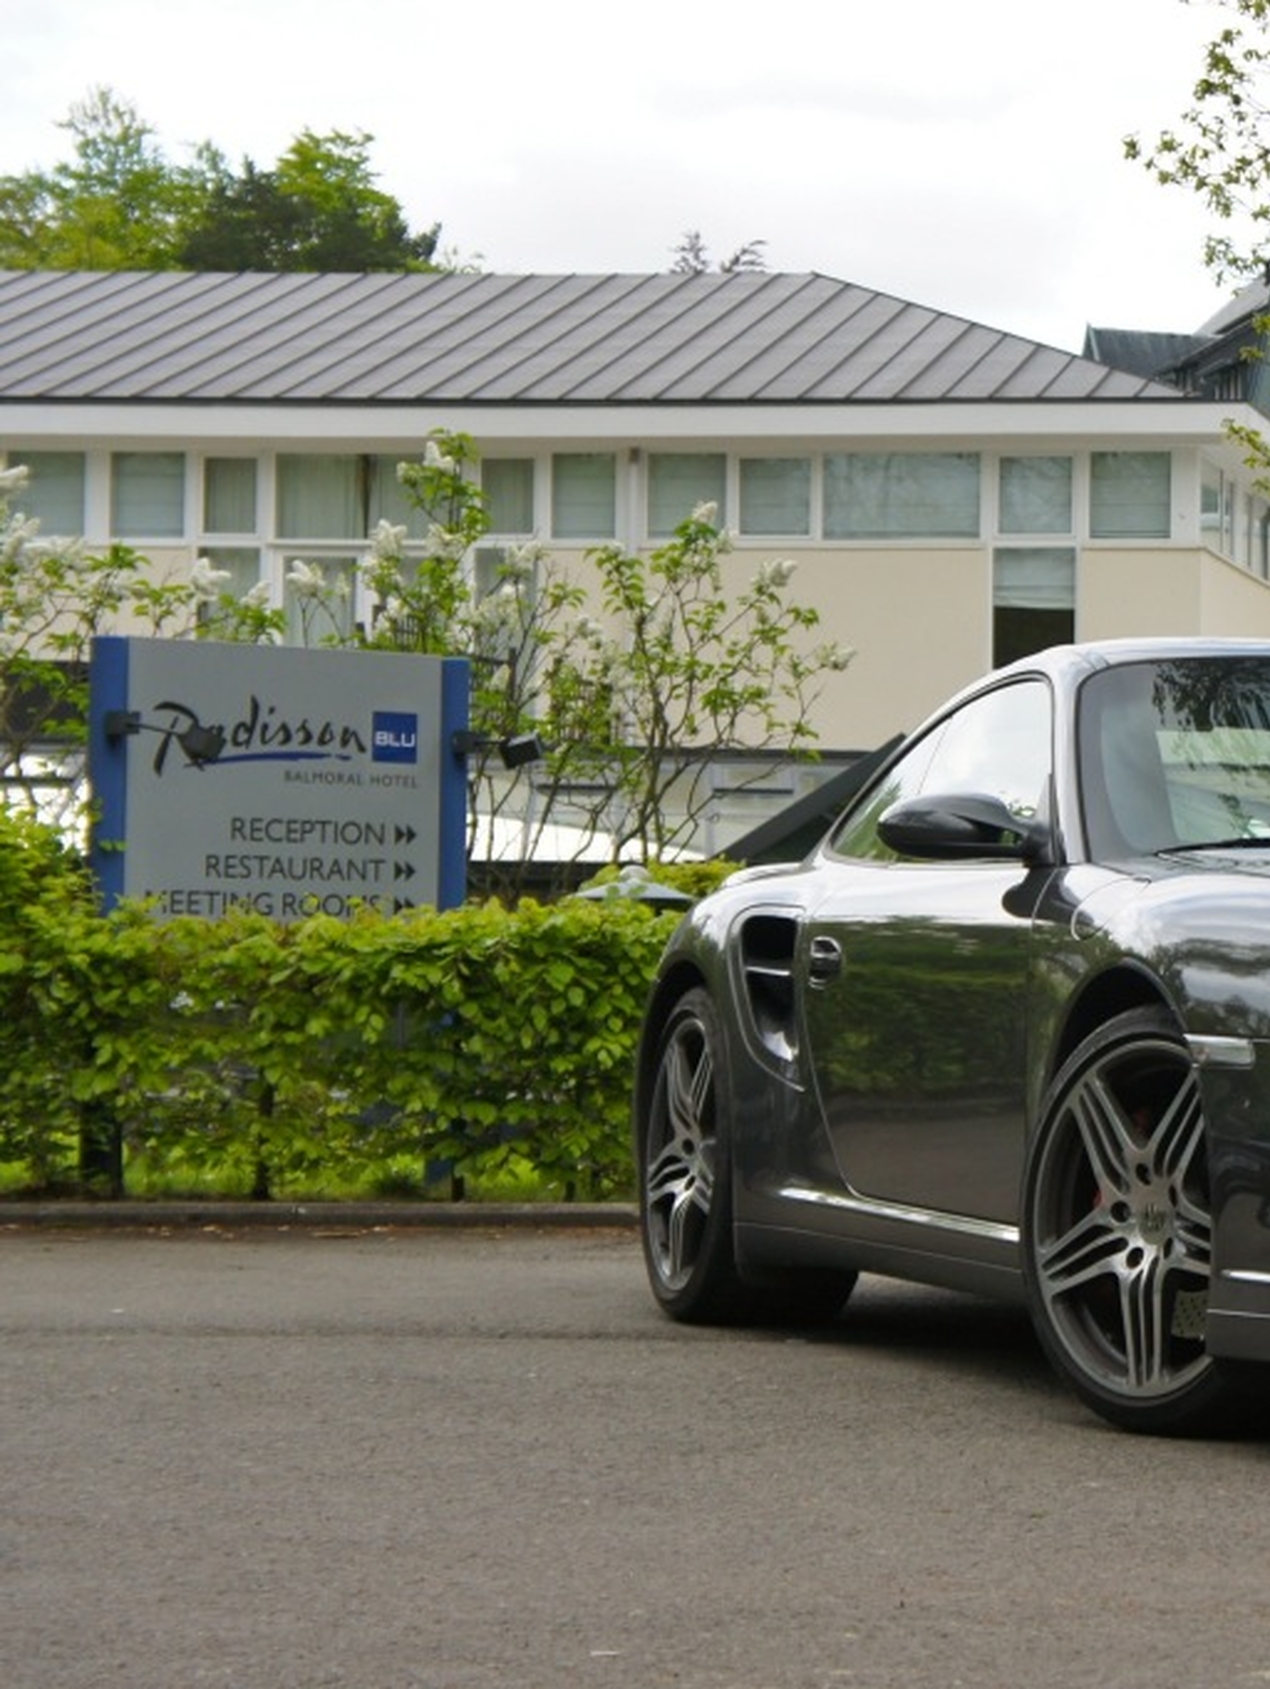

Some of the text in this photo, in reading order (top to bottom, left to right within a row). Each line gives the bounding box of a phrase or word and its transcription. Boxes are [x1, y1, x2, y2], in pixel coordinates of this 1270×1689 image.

[374, 731, 416, 748] BLU
[284, 770, 418, 788] BALMORAL HOTEL
[230, 816, 385, 846] RECEPTION
[204, 854, 386, 882] RESTAURANT
